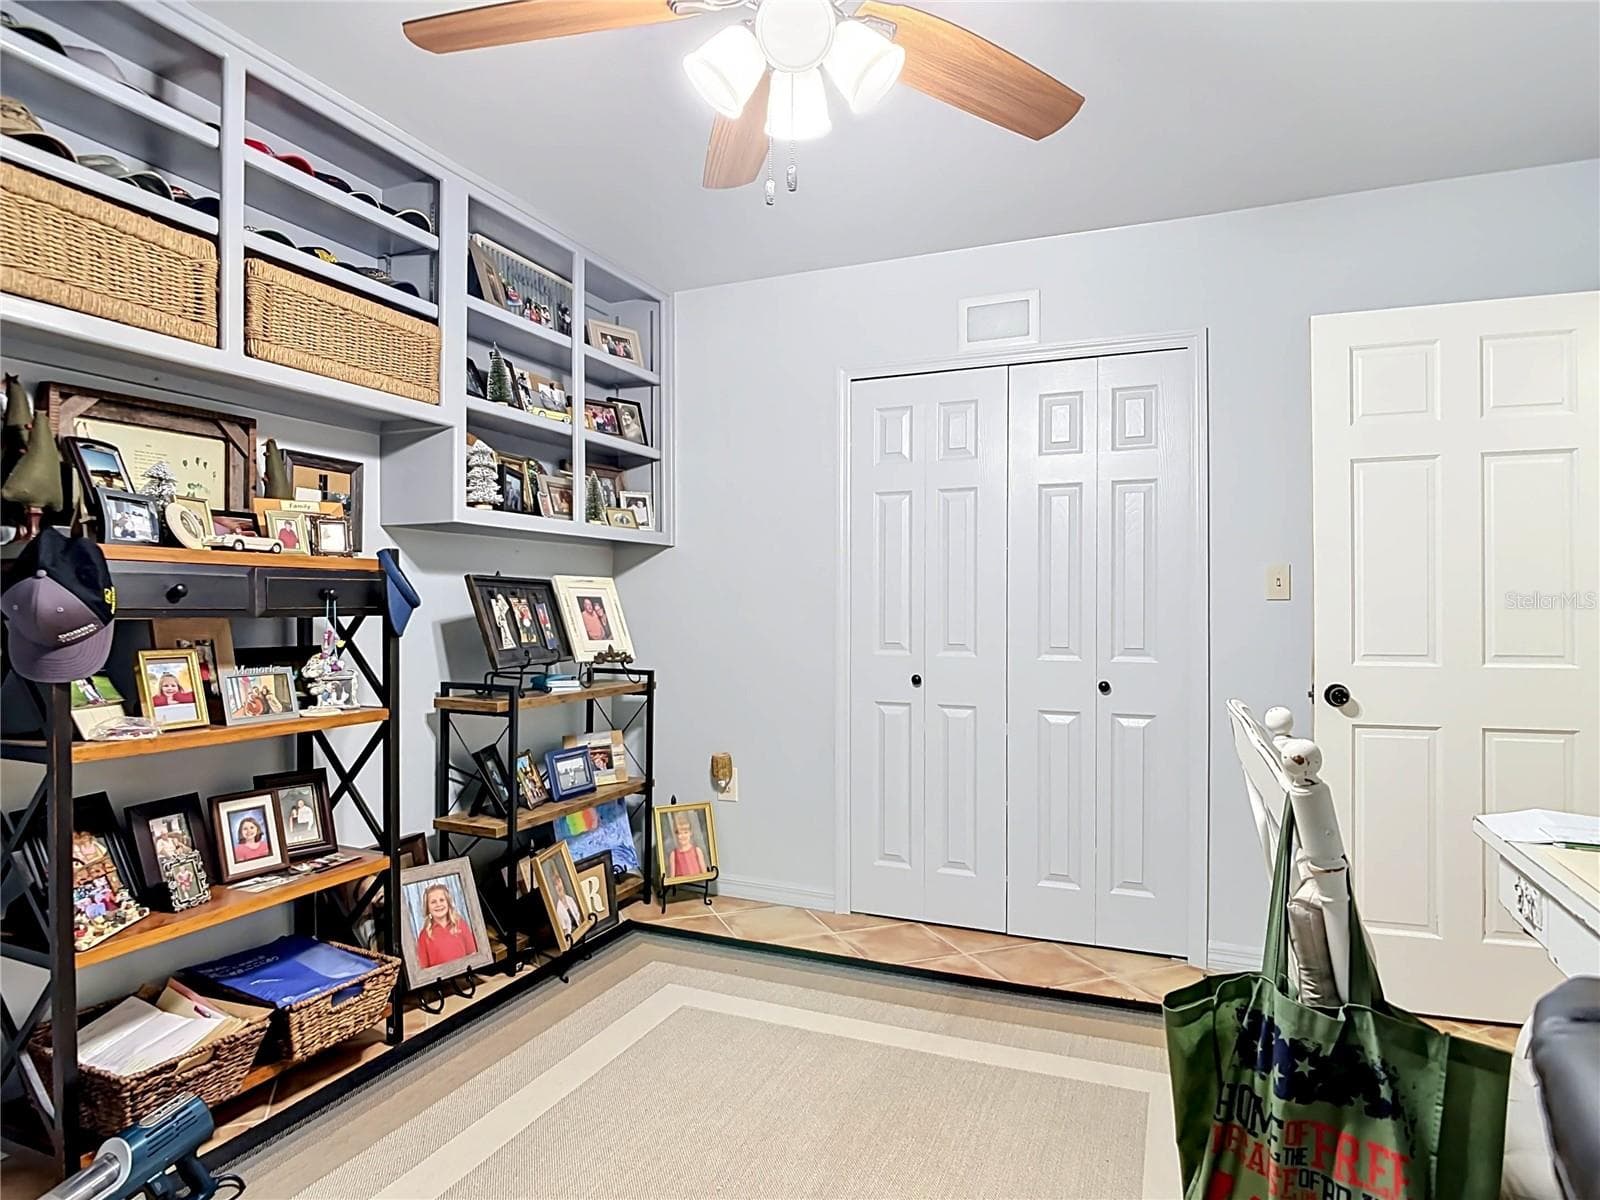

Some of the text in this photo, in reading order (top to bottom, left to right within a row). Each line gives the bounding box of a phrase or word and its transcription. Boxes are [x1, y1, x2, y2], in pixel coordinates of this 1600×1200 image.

[580, 876, 605, 913] R
[1284, 1119, 1311, 1146] OF
[1282, 1146, 1308, 1168] THE
[1298, 1168, 1320, 1190] OF
